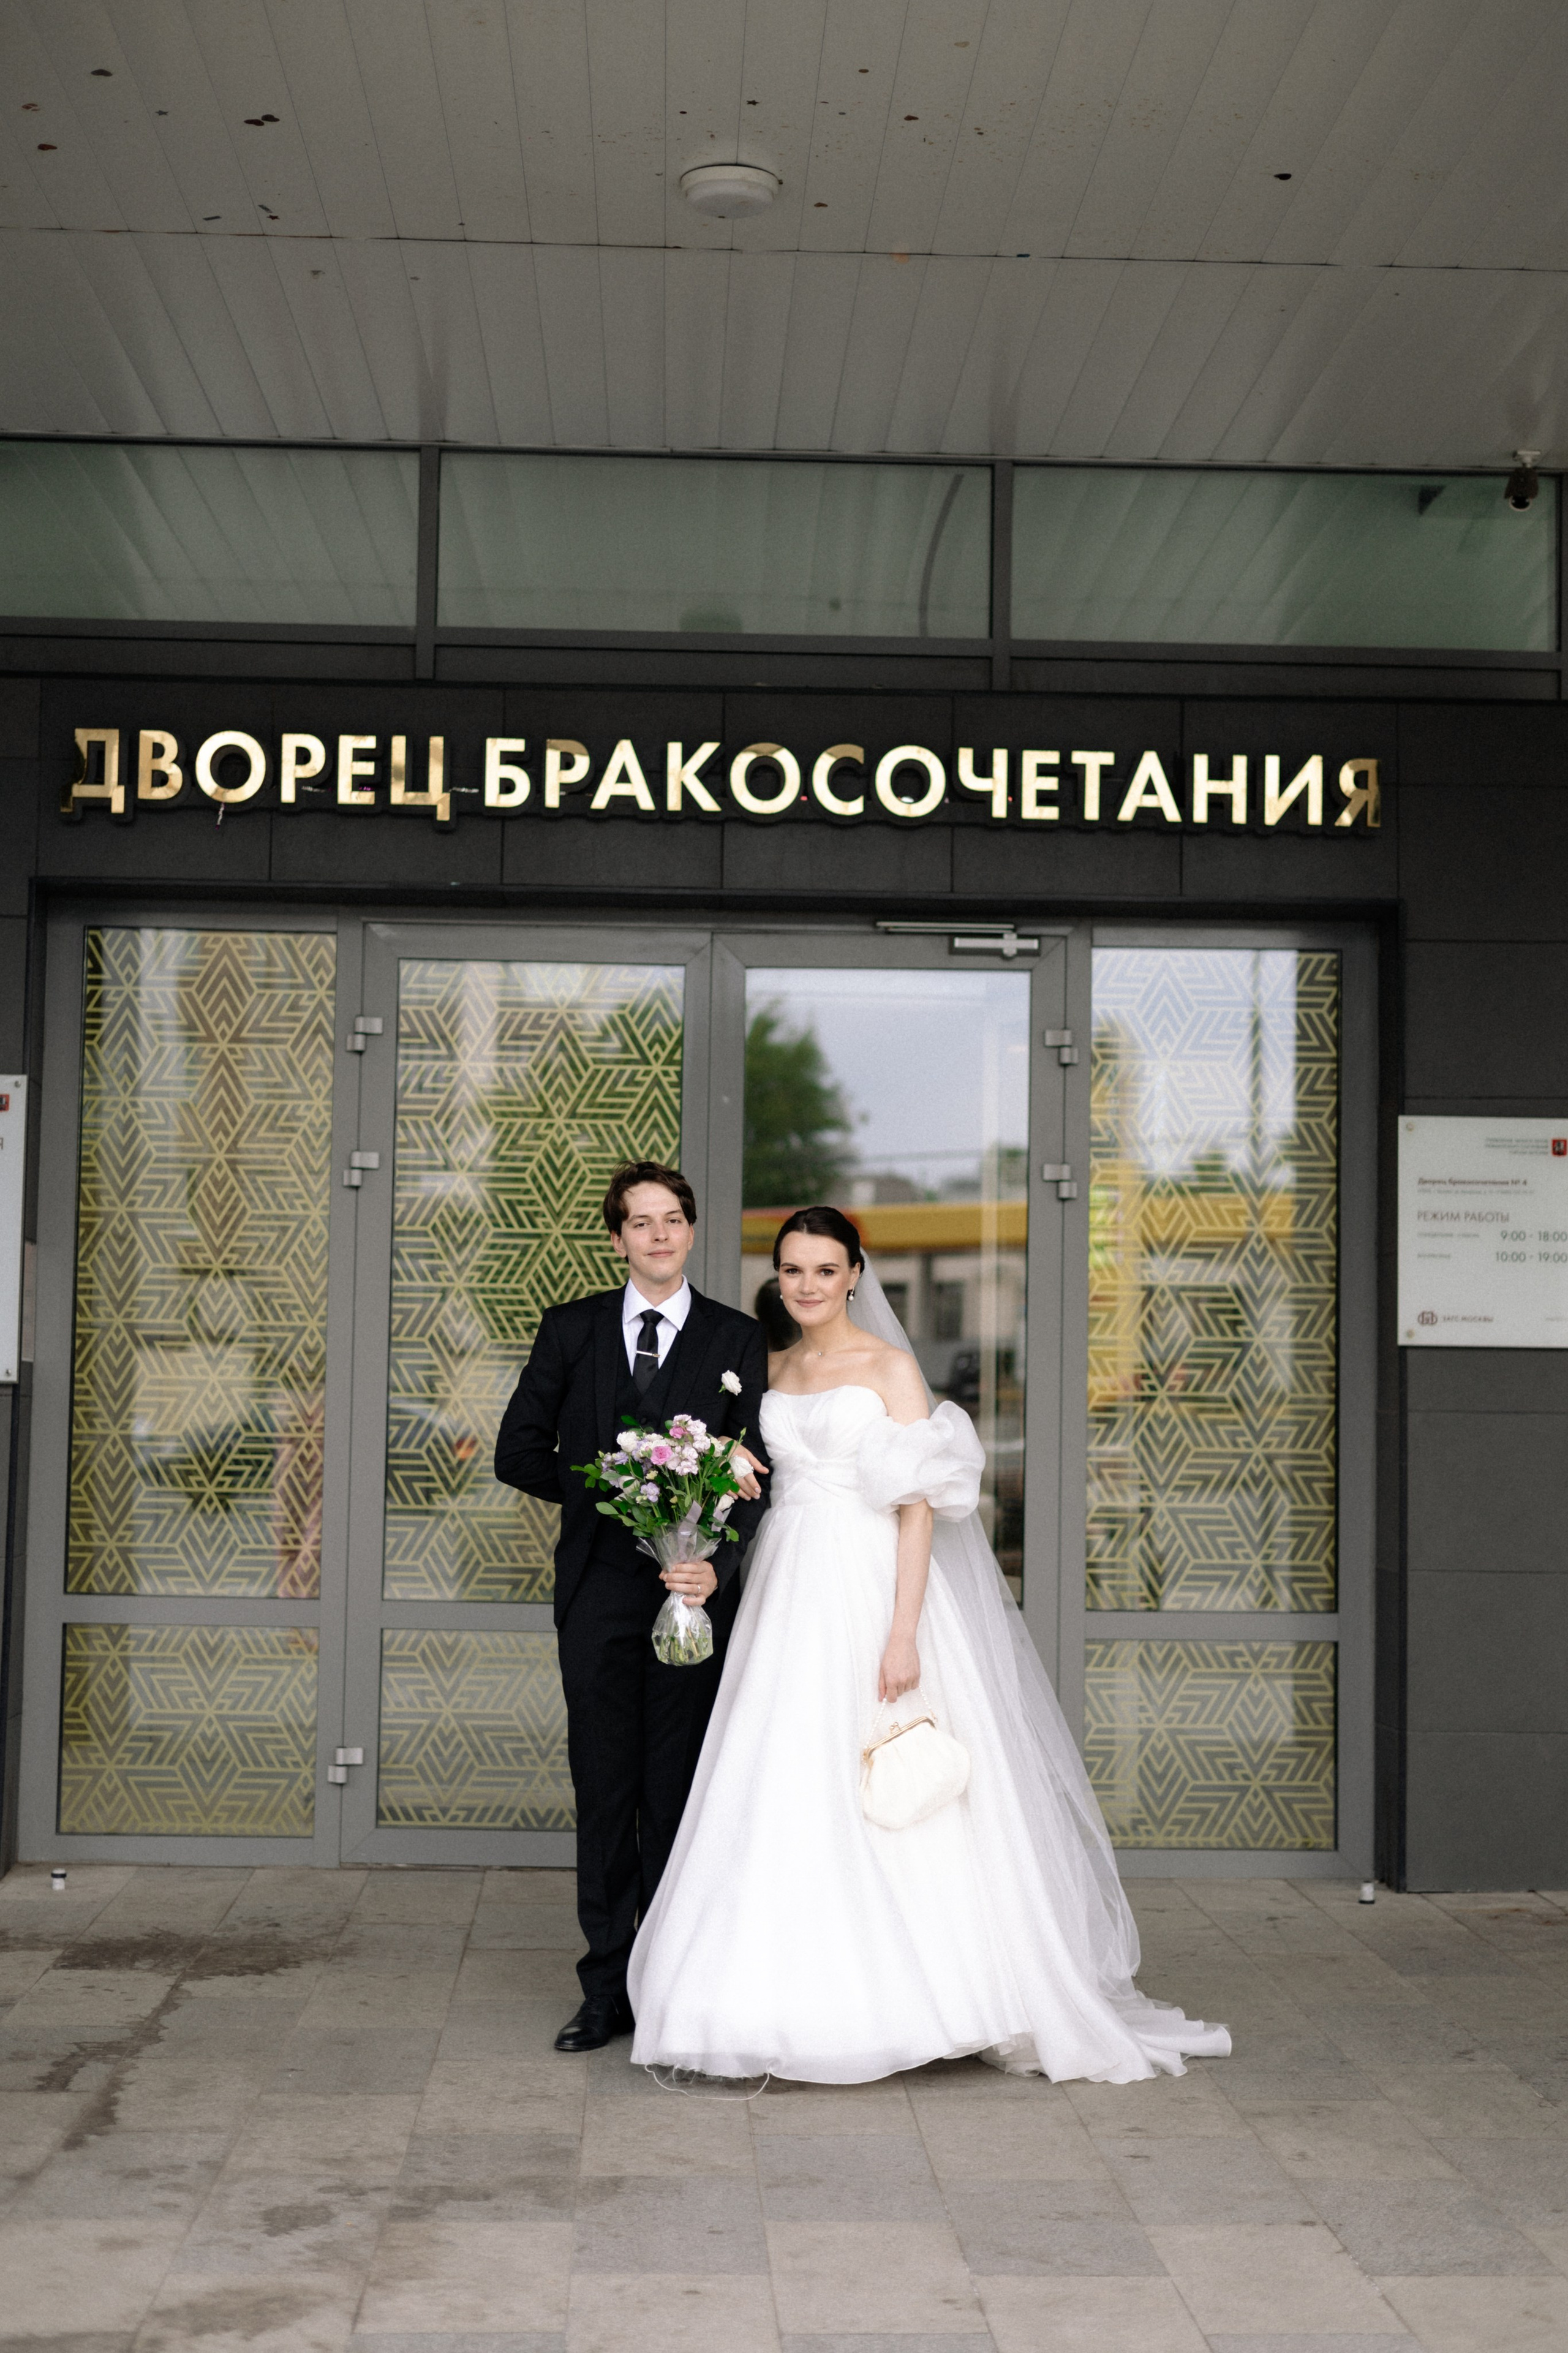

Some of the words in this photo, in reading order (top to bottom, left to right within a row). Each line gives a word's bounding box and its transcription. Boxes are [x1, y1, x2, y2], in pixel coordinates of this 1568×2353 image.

[61, 728, 451, 821] ДВОРЕЦ
[484, 737, 1381, 828] БРАКОСОЧЕТАНИЯ
[1417, 1210, 1461, 1222] РЕЖИМ
[1464, 1211, 1510, 1223] РАБОТЫ
[1500, 1230, 1526, 1242] 9:00
[1538, 1230, 1568, 1242] 18:00
[1496, 1251, 1526, 1263] 10:00
[1538, 1251, 1568, 1264] 19:00
